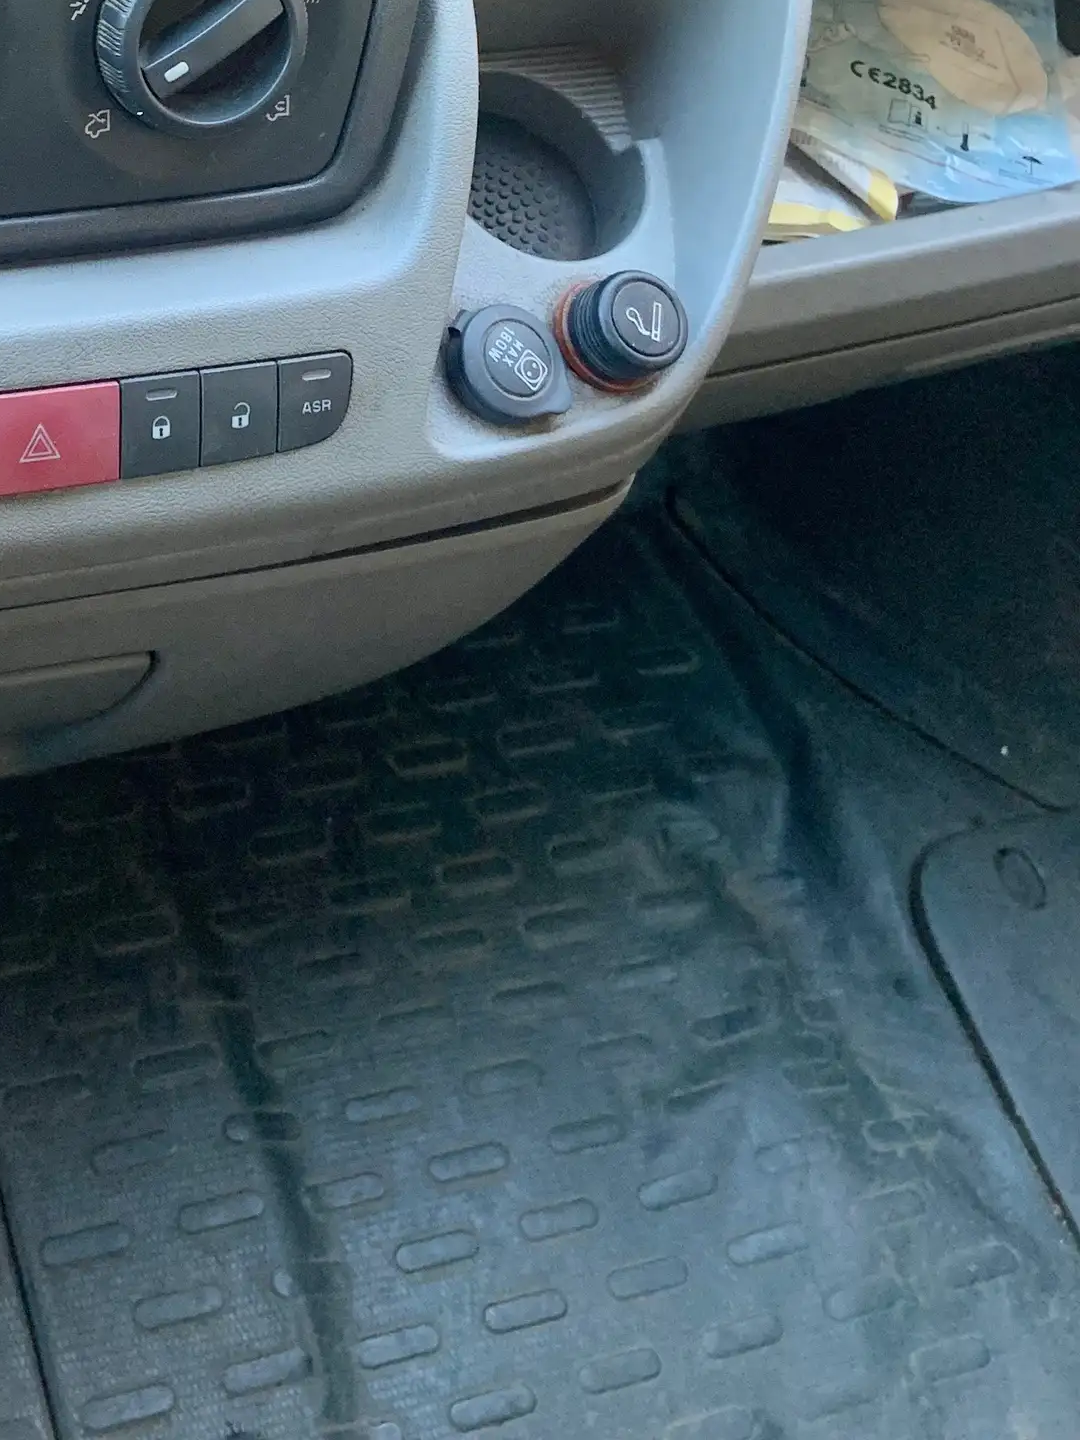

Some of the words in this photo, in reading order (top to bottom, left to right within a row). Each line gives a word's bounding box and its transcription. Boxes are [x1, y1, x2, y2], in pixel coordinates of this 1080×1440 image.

[488, 326, 516, 363] 180W
[502, 339, 525, 368] MAX
[302, 399, 332, 415] ASR
